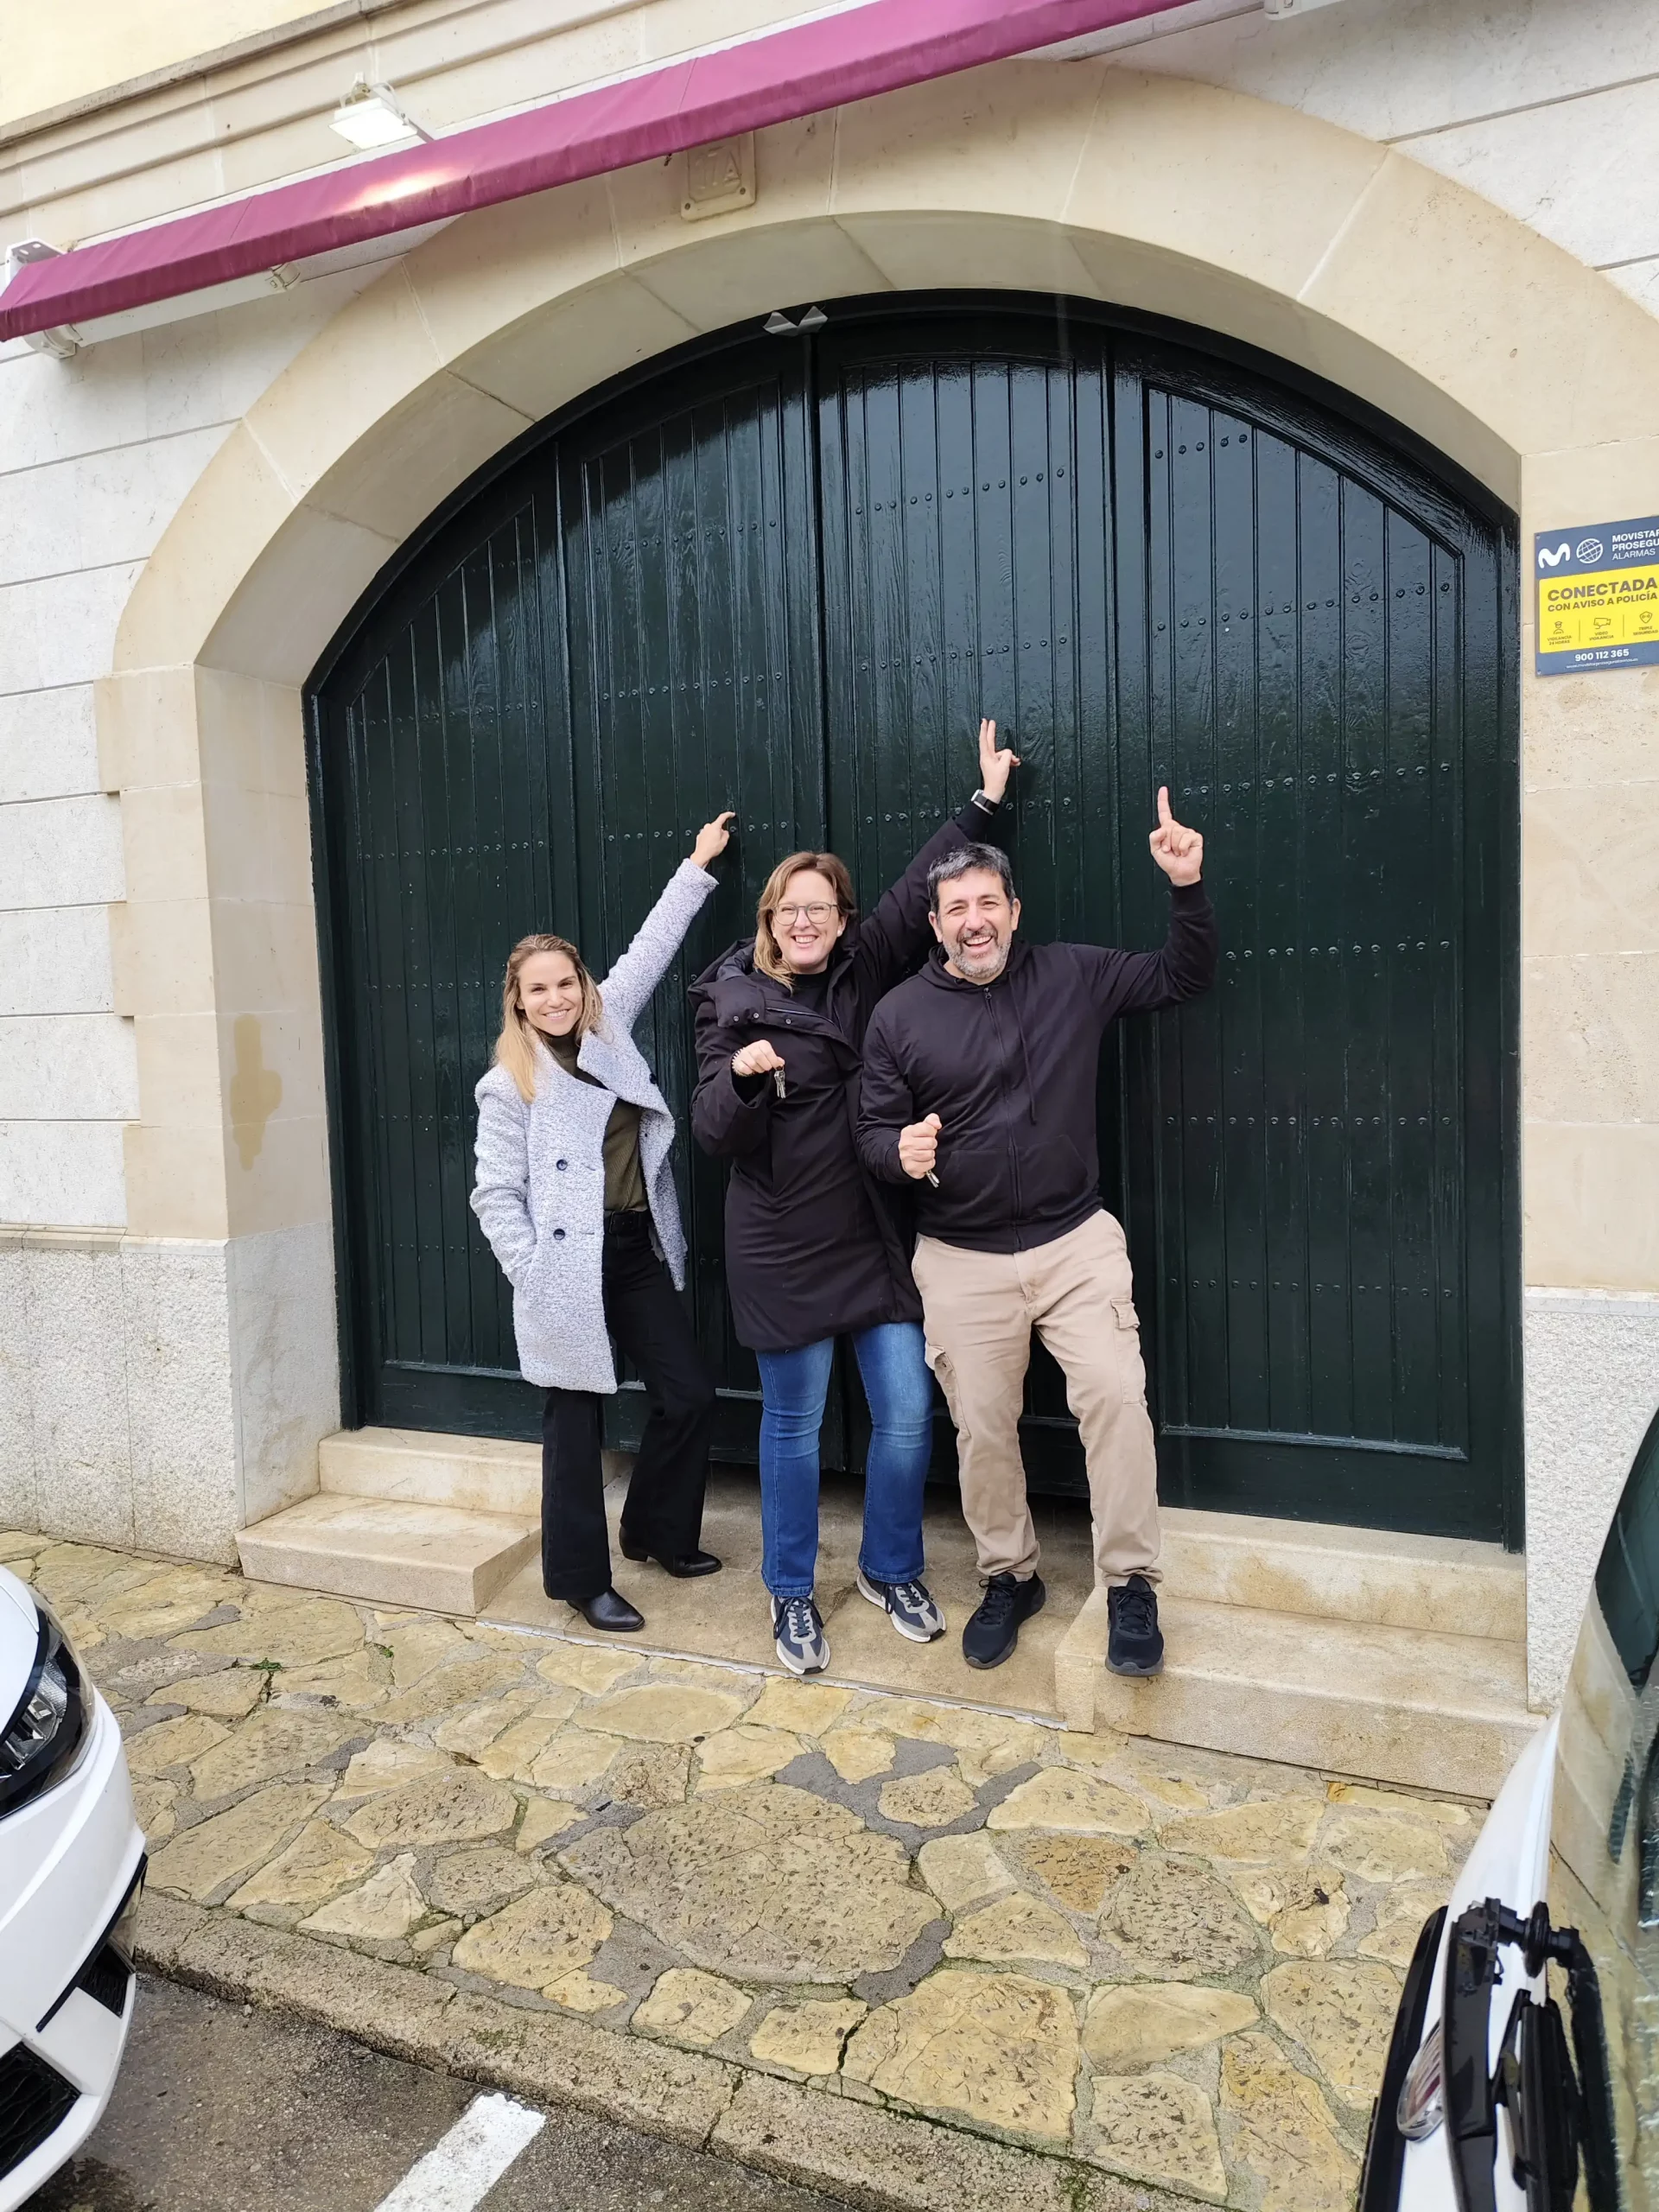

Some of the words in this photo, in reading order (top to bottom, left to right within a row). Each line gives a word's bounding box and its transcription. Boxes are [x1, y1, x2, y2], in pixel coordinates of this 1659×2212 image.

[1612, 548, 1656, 561] ALARMAS
[1548, 577, 1658, 601] CONECTADA
[1548, 603, 1571, 612] CON
[1573, 598, 1605, 610] AVISO
[1606, 597, 1614, 606] A
[1617, 591, 1658, 604] POLICÍA
[1574, 652, 1593, 662] 900
[1595, 651, 1609, 659] 112
[1611, 648, 1630, 658] 365
